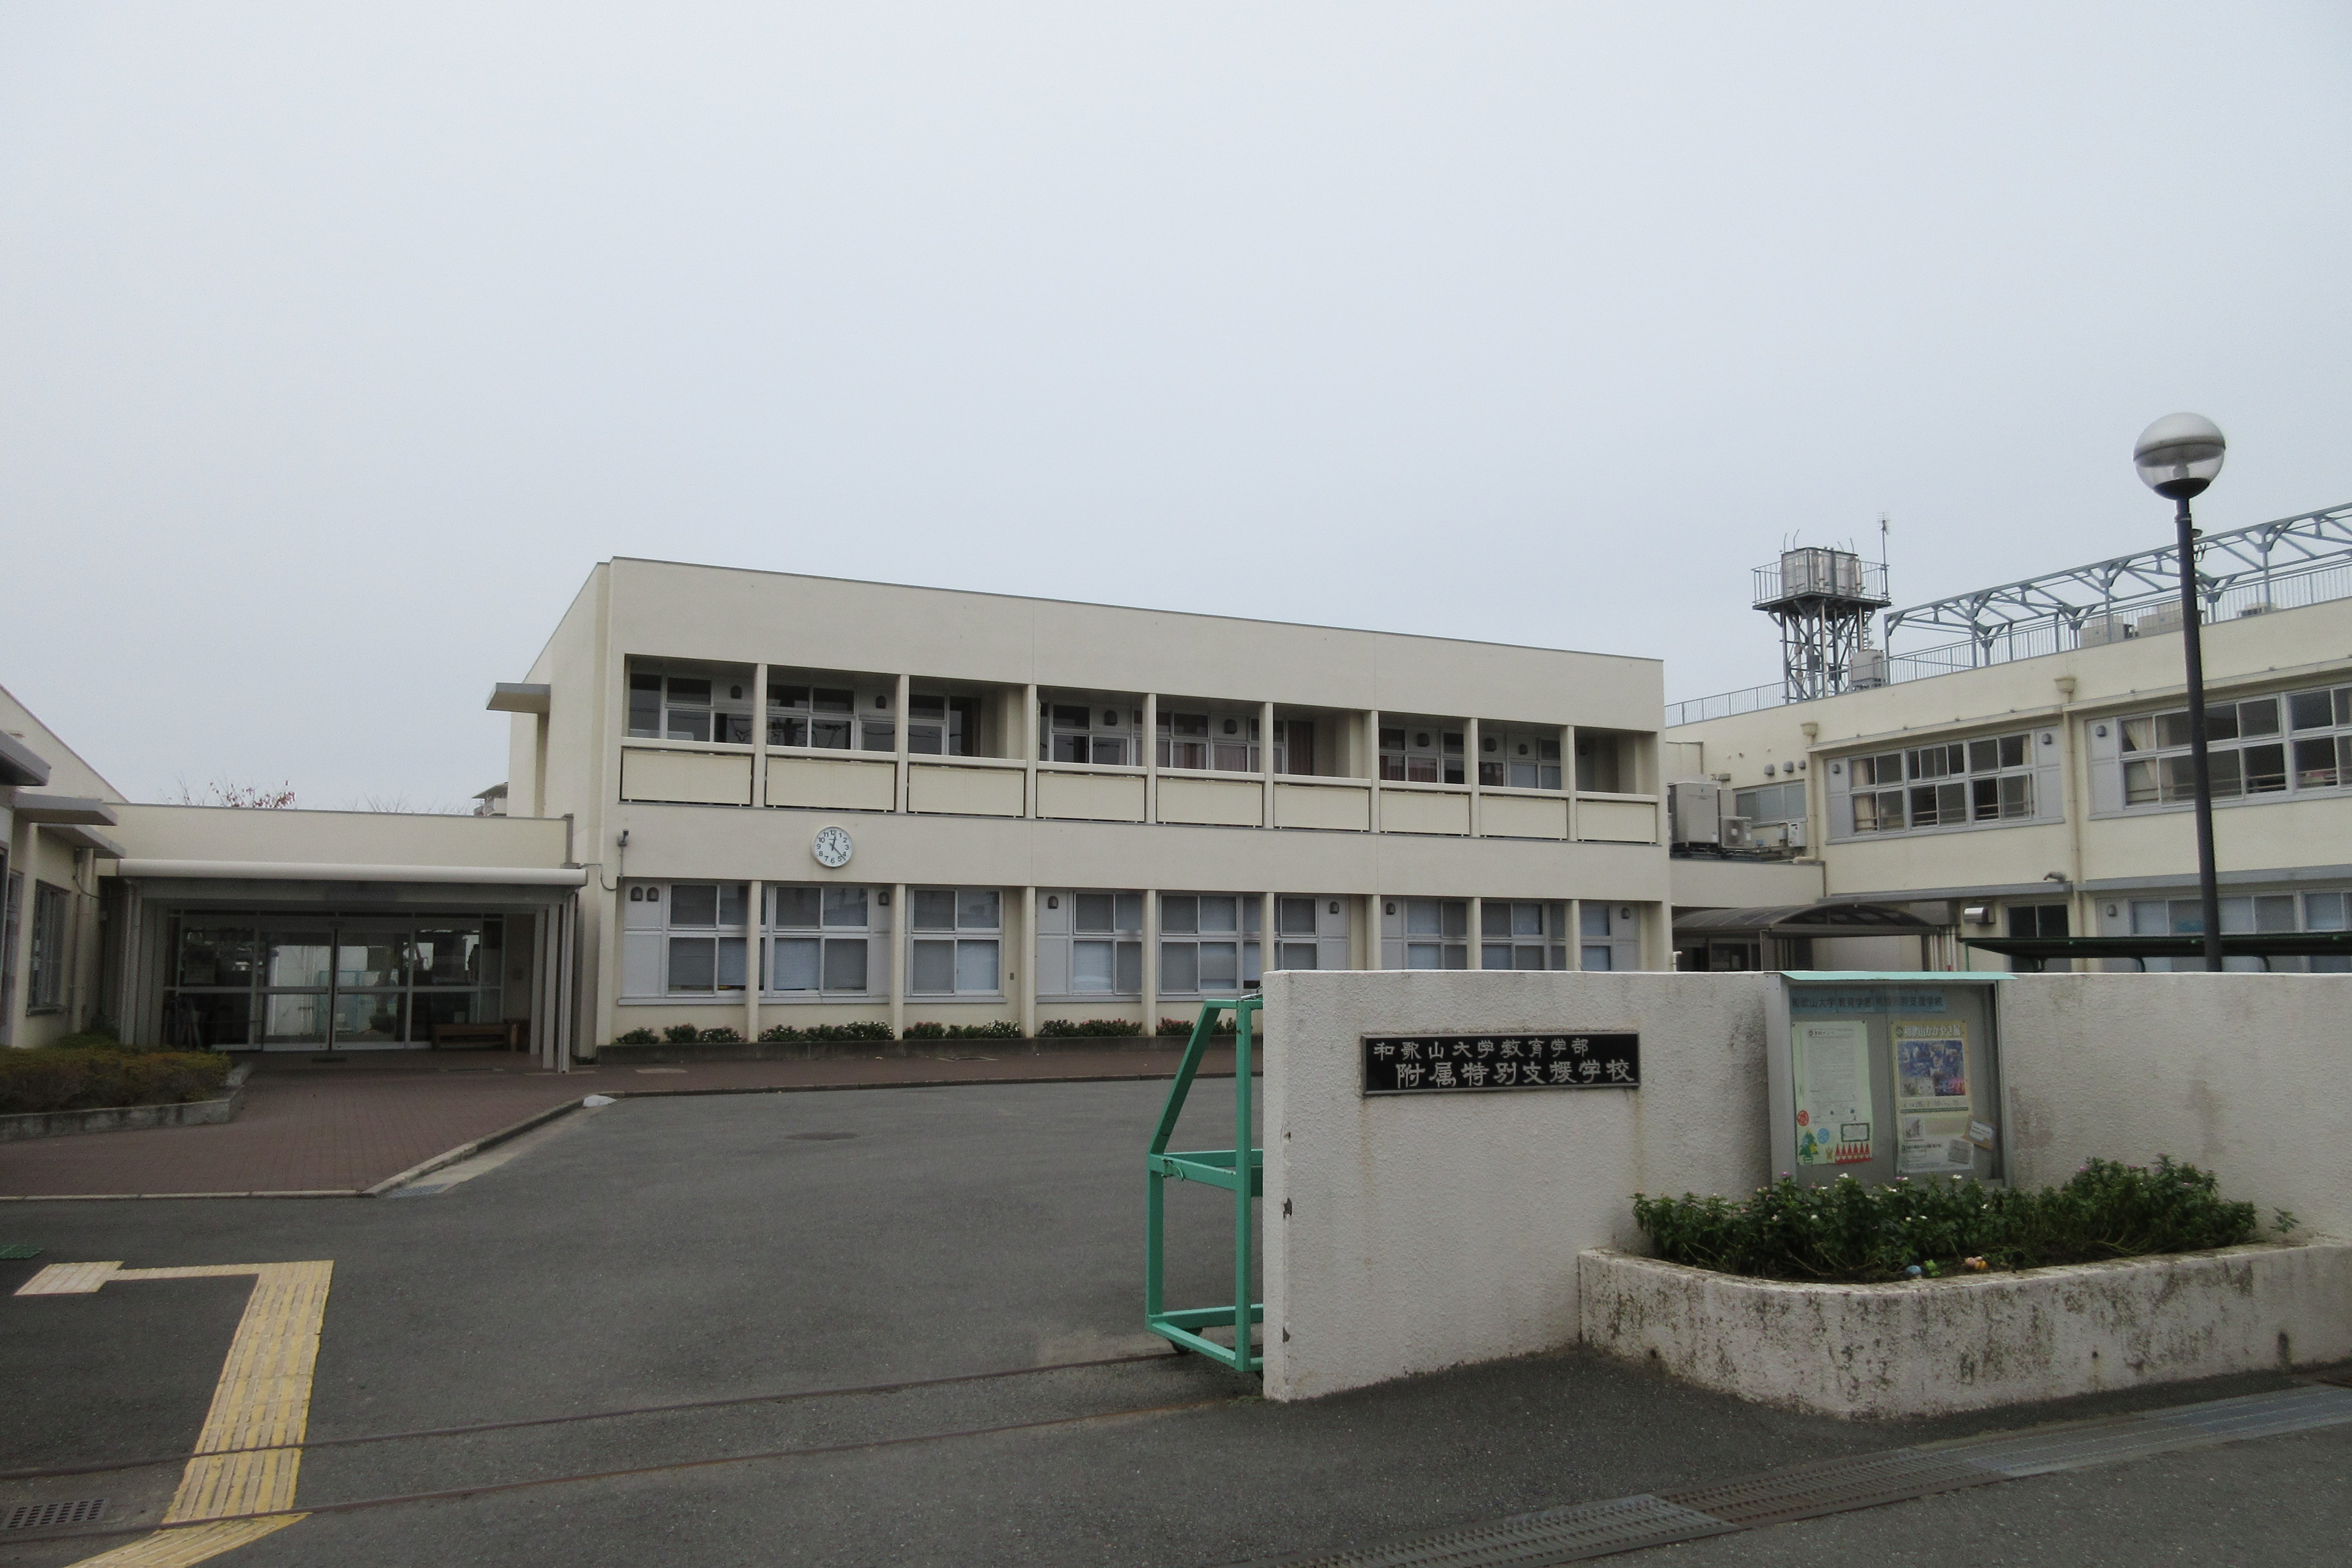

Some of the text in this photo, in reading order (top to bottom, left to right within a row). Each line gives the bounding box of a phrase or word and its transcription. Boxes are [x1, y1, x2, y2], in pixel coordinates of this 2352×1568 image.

[1792, 996, 1943, 1008] 和歌山大学教育学部附属別支援学校
[1374, 1037, 1589, 1061] 和歌山大学教育学部
[1395, 1058, 1635, 1090] 附属特別支援学校
